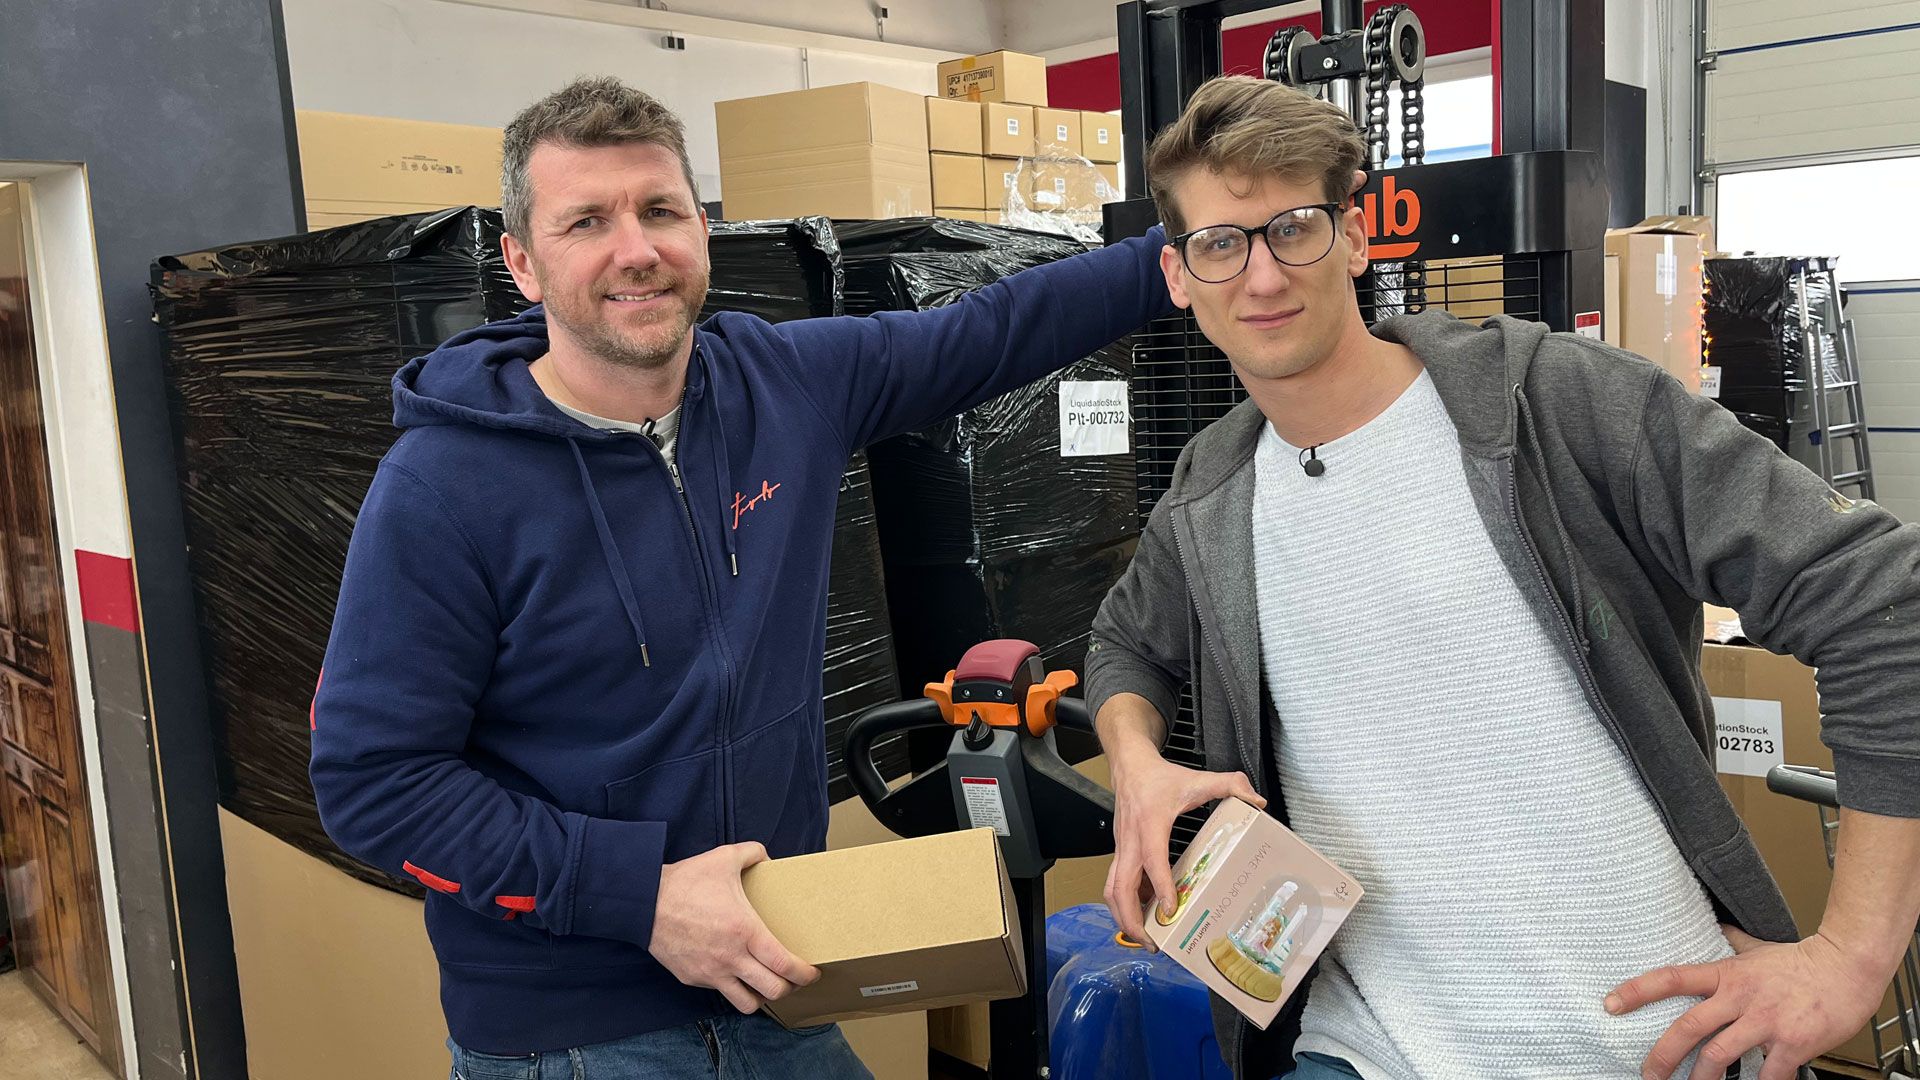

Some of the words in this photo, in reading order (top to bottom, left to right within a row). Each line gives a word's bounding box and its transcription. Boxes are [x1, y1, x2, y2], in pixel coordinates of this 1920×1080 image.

[1068, 410, 1125, 426] Plt-002732
[1715, 736, 1774, 754] 02783
[1247, 840, 1272, 869] MAKE
[1228, 871, 1255, 898] YOUR
[1210, 897, 1232, 924] OWN
[1197, 921, 1211, 940] NIGHT
[1186, 938, 1199, 954] LIGHT
